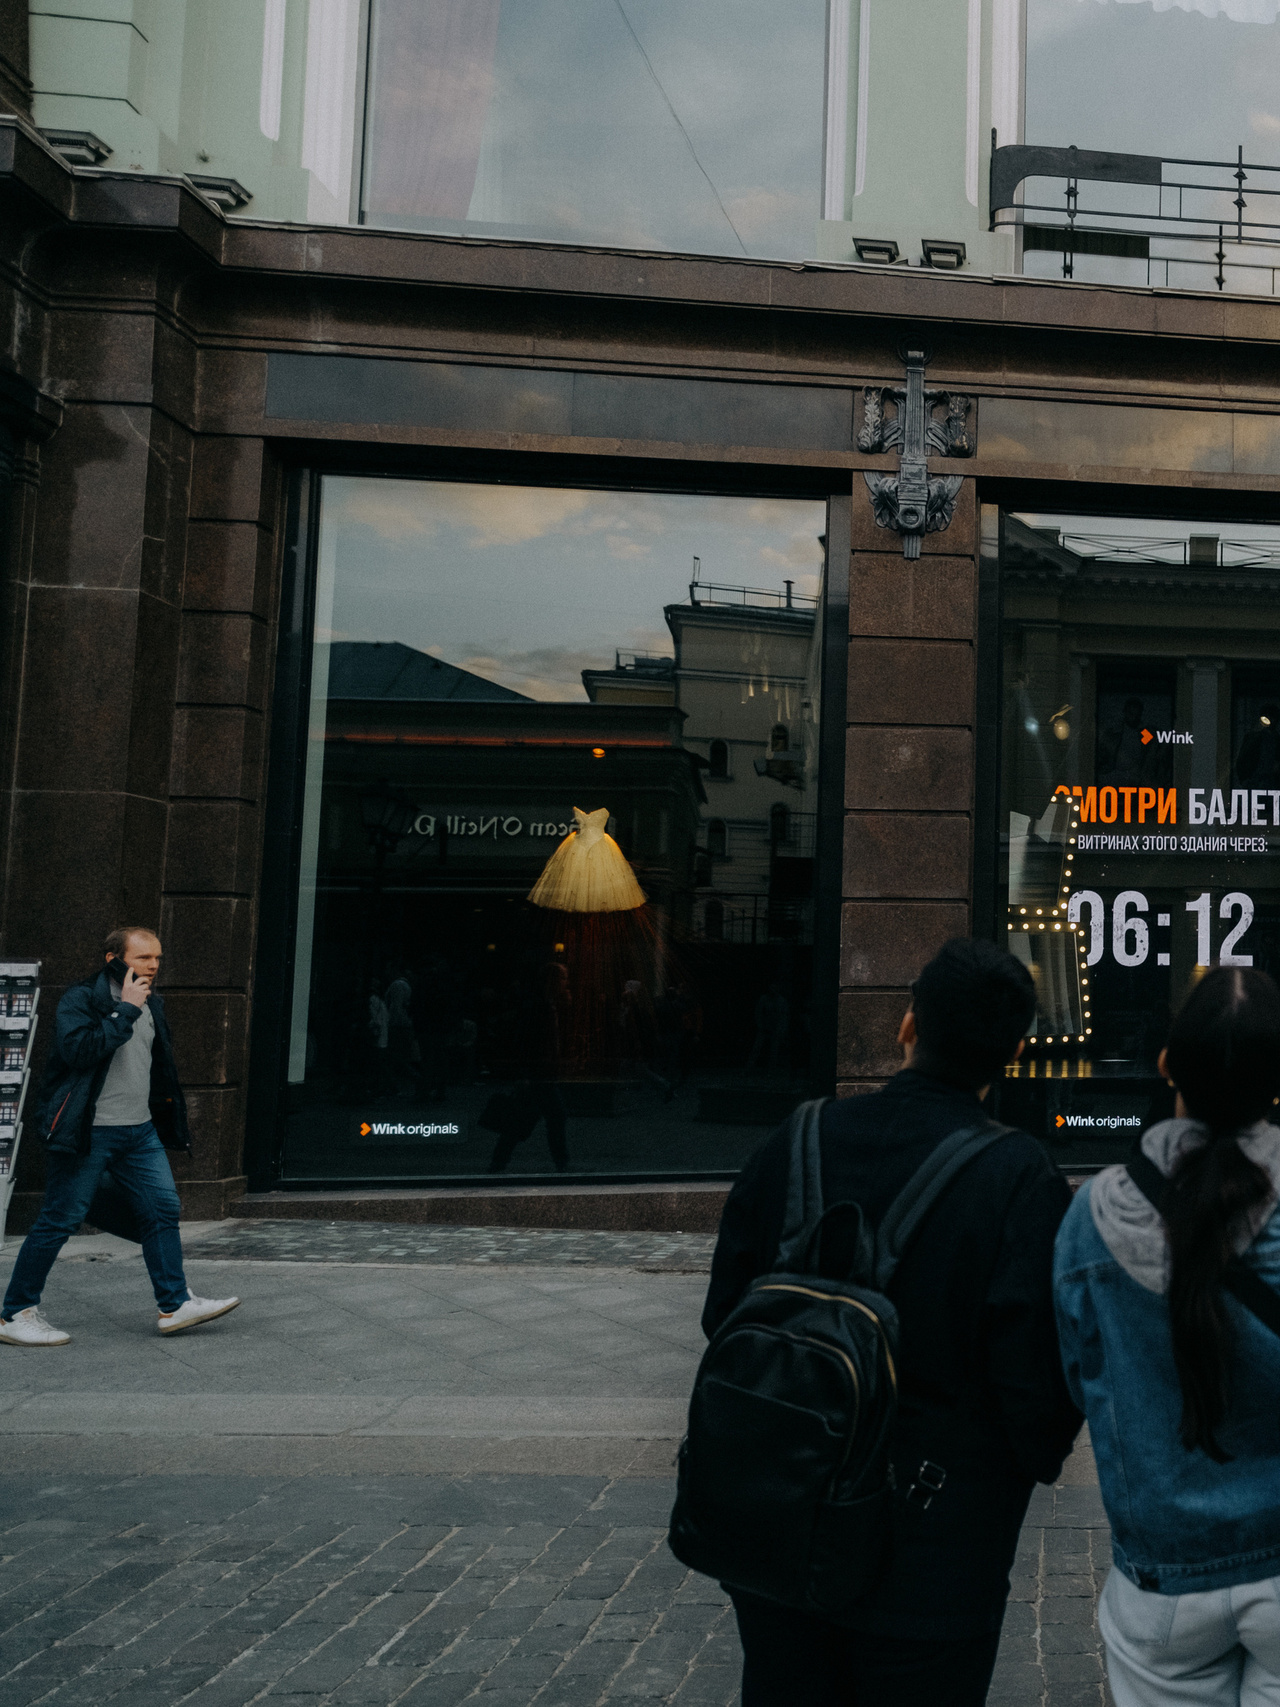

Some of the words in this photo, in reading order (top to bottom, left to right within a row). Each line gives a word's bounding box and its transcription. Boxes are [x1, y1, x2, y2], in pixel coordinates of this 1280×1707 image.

[1156, 730, 1194, 745] Wink
[1077, 834, 1140, 851] ВИТРИНАХ
[1141, 836, 1178, 851] ЭТОГО
[1180, 836, 1227, 853] ЗДАНИЯ
[1229, 837, 1269, 852] ЧЕРЕЗ:
[372, 1122, 406, 1135] Wink
[406, 1122, 459, 1137] originals
[1066, 1115, 1095, 1127] Wink
[1096, 1115, 1142, 1129] originals
